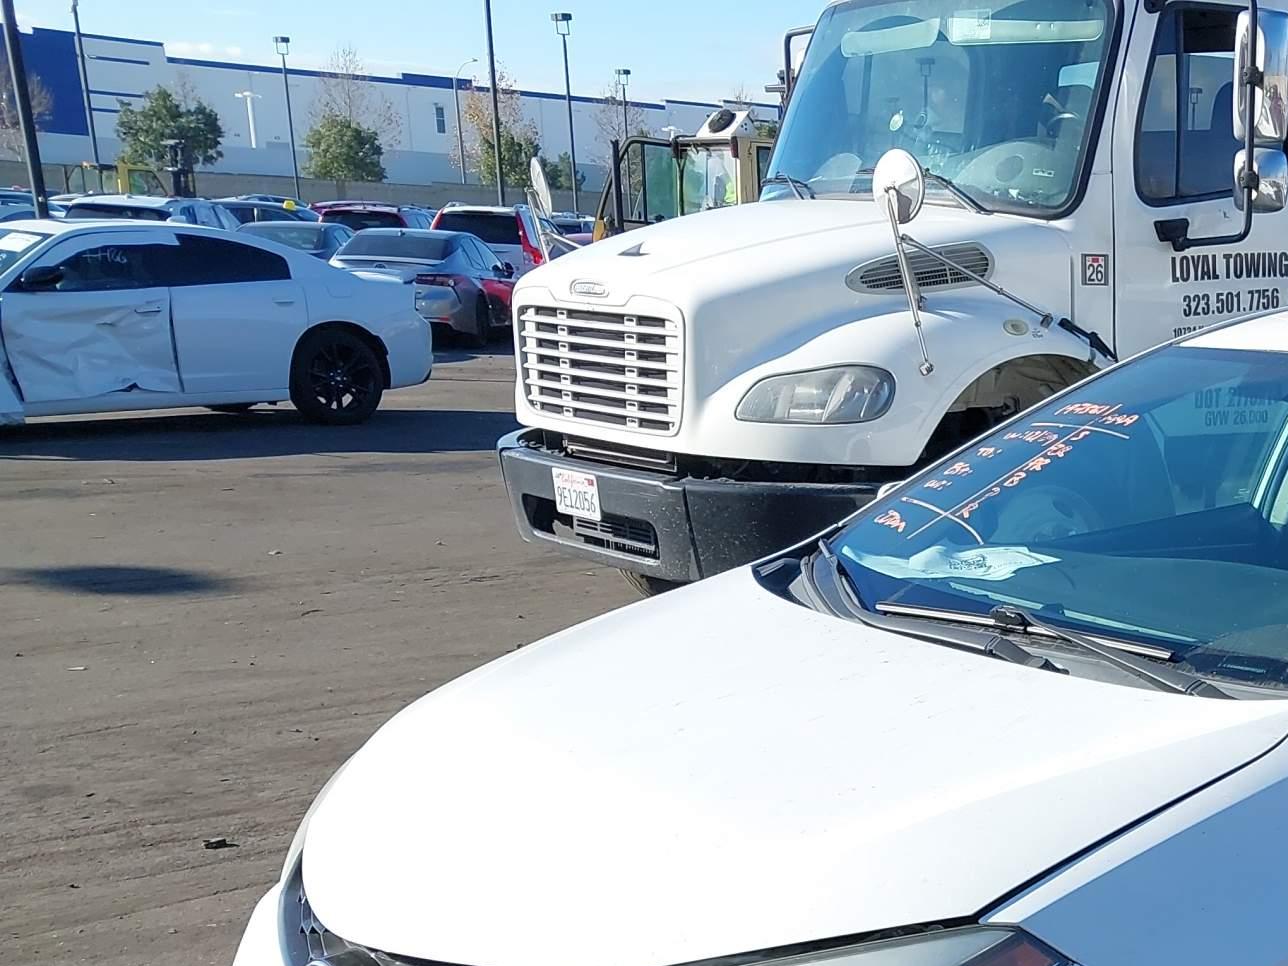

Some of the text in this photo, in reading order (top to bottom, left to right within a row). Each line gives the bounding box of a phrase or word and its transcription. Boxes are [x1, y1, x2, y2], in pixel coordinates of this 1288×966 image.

[1087, 263, 1104, 282] 26
[1171, 252, 1288, 283] LOYAL TOWING
[1182, 288, 1280, 318] 323.501.7756
[1205, 411, 1230, 427] GVW
[556, 486, 596, 513] 9E12056
